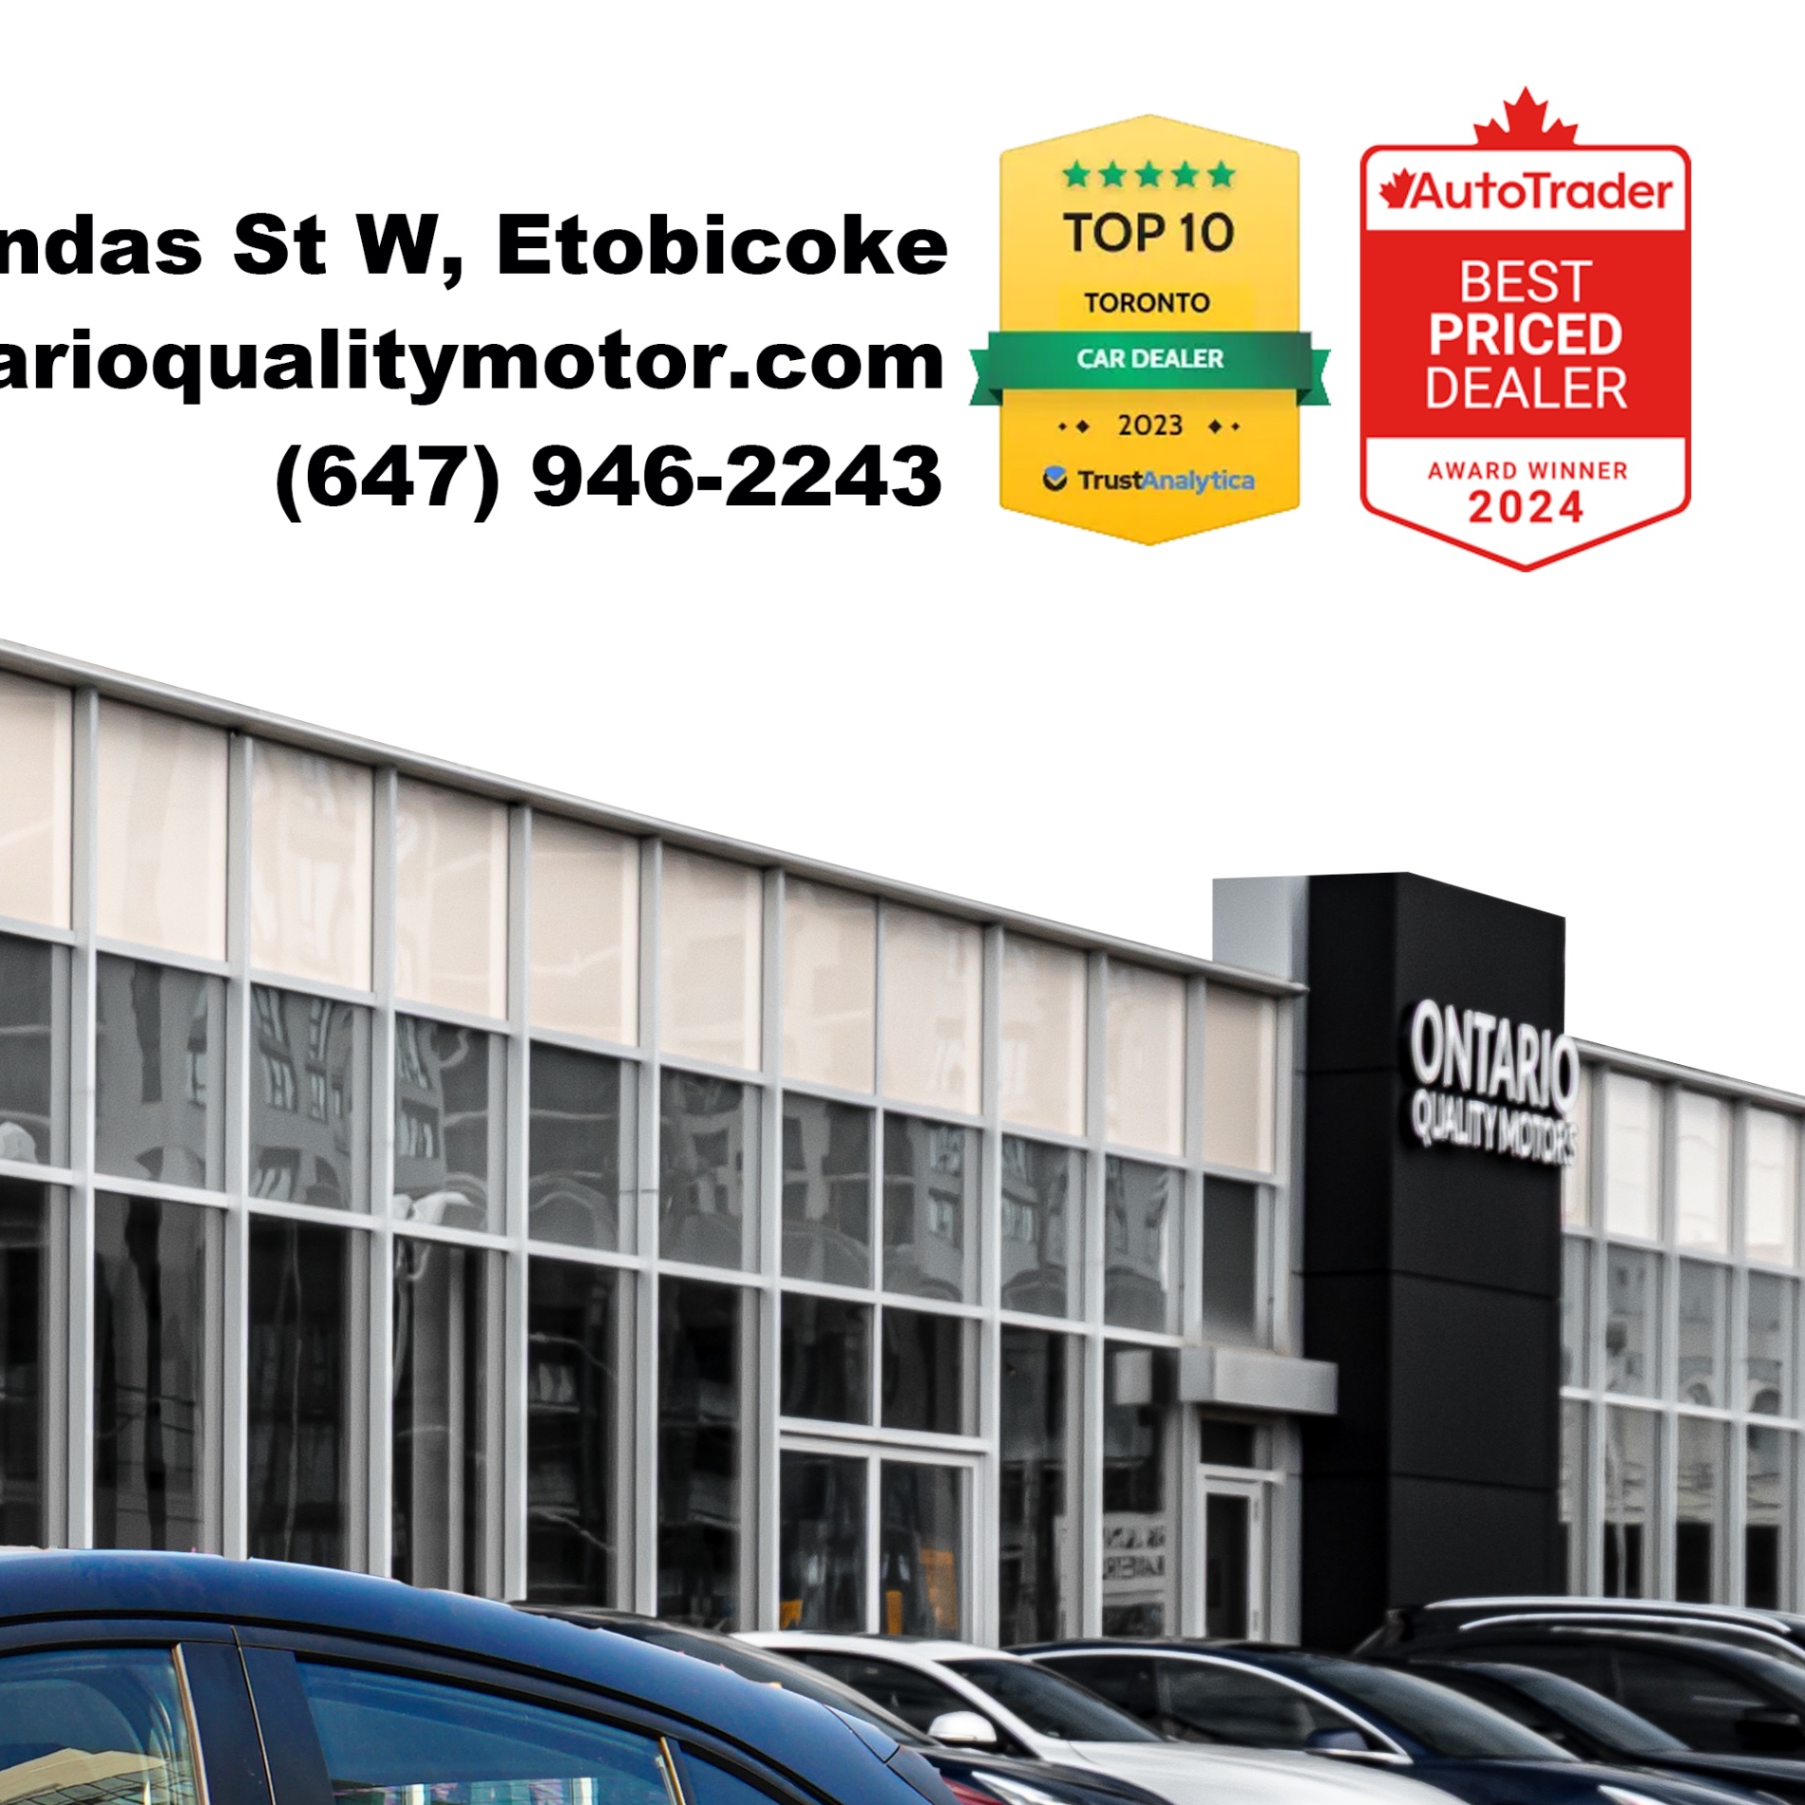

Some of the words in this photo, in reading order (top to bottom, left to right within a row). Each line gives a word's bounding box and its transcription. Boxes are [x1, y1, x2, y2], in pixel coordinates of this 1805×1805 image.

[1410, 998, 1580, 1116] ONTARIO
[1411, 1088, 1497, 1151] QUALITY
[1497, 1106, 1577, 1166] MOTORS
